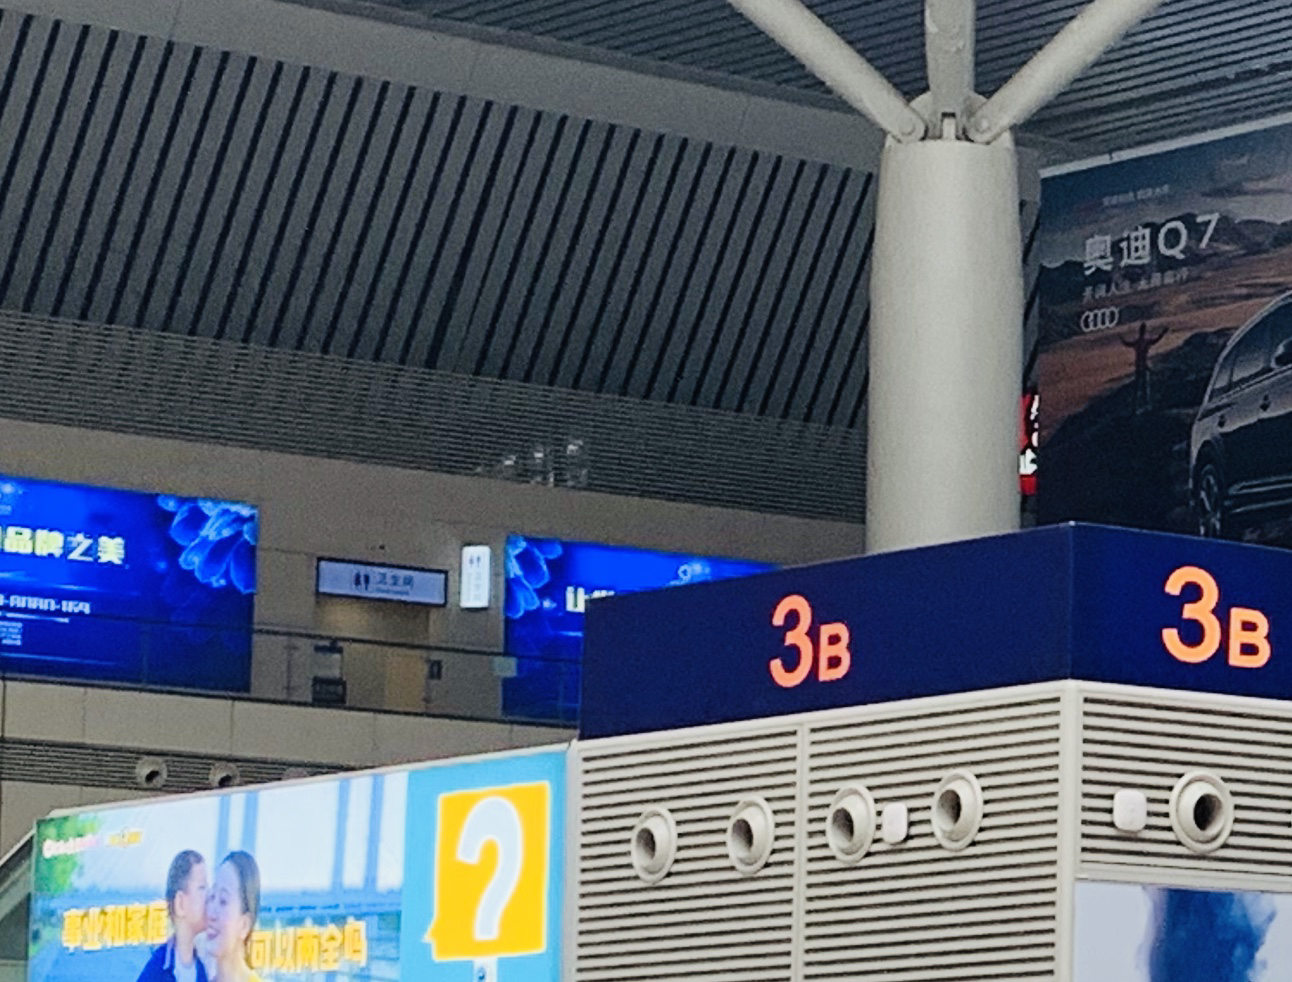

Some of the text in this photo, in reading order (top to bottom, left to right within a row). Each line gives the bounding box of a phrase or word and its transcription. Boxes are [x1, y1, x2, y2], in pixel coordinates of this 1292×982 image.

[0, 525, 125, 564] 品牌之美
[769, 594, 851, 688] 3B
[1161, 566, 1271, 668] 3B
